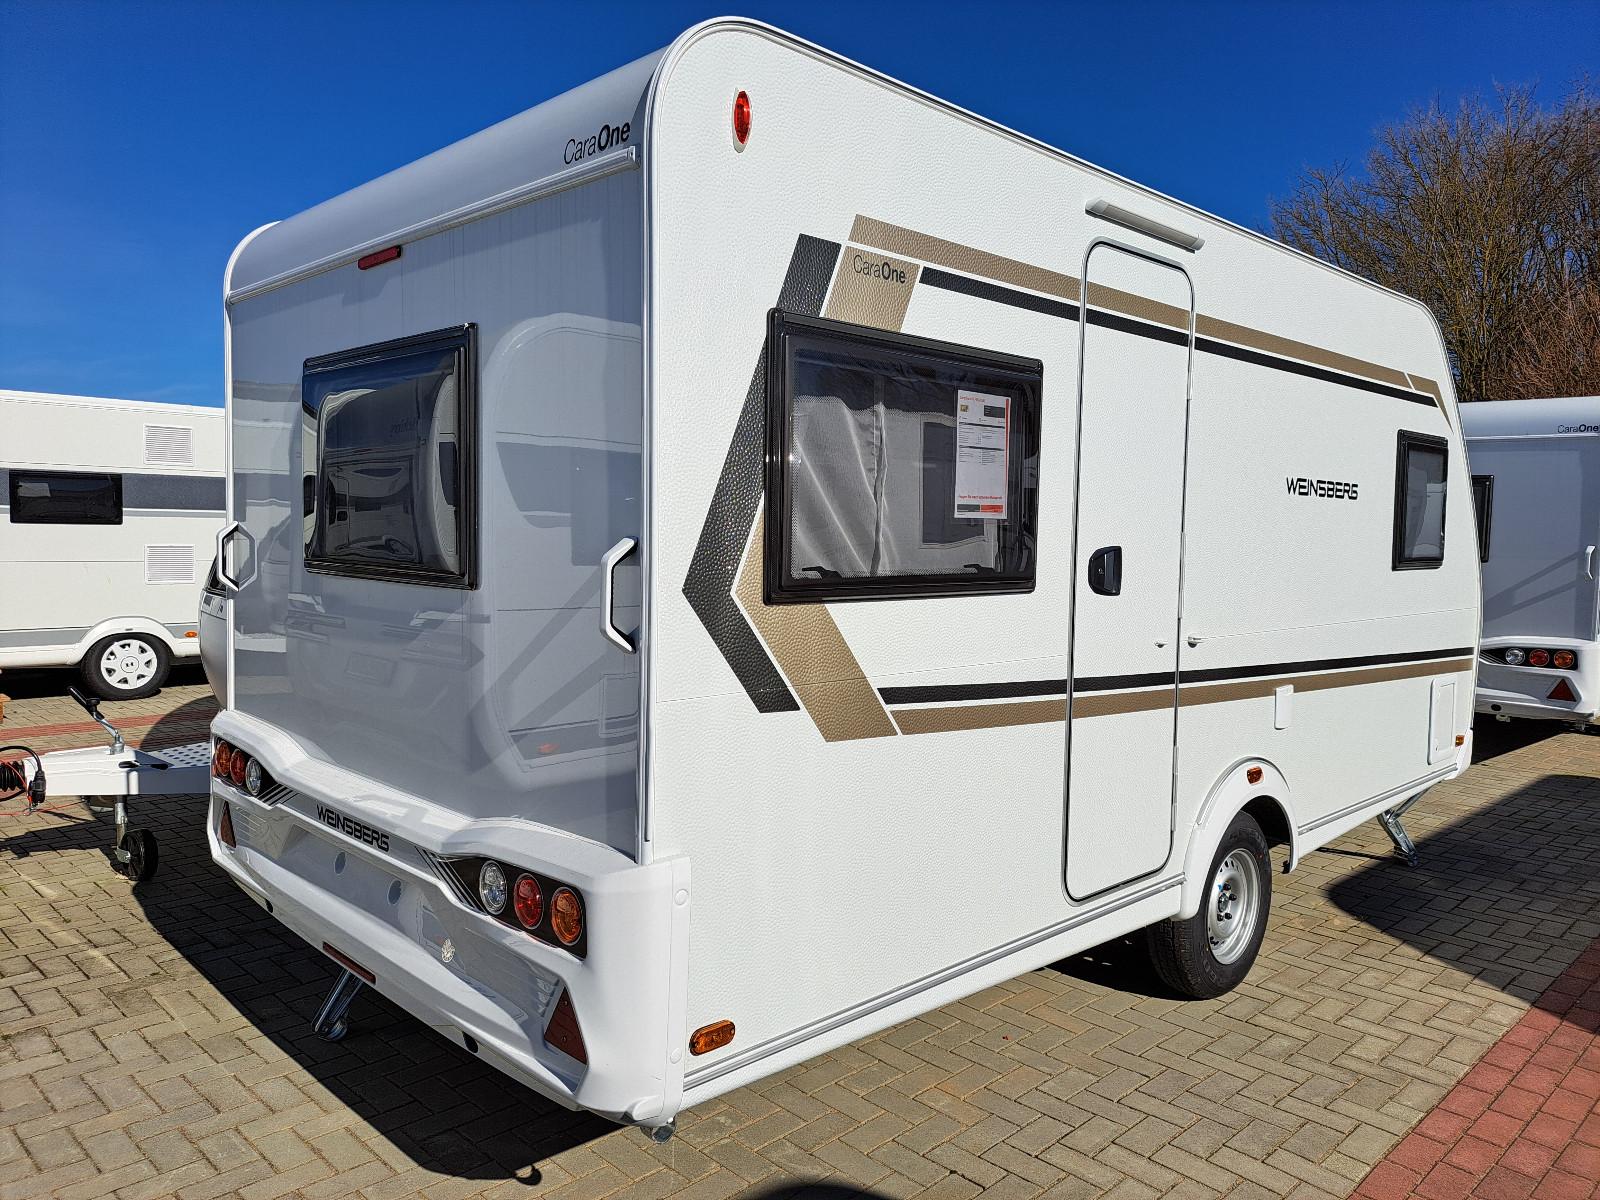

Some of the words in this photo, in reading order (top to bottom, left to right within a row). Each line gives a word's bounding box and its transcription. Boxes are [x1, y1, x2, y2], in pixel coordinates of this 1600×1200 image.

[563, 122, 631, 164] CaraOne
[853, 254, 906, 284] CaraOne
[1557, 424, 1599, 433] CaraOne
[1286, 477, 1358, 500] WEINSBERG
[316, 803, 389, 852] WEINSBERG
